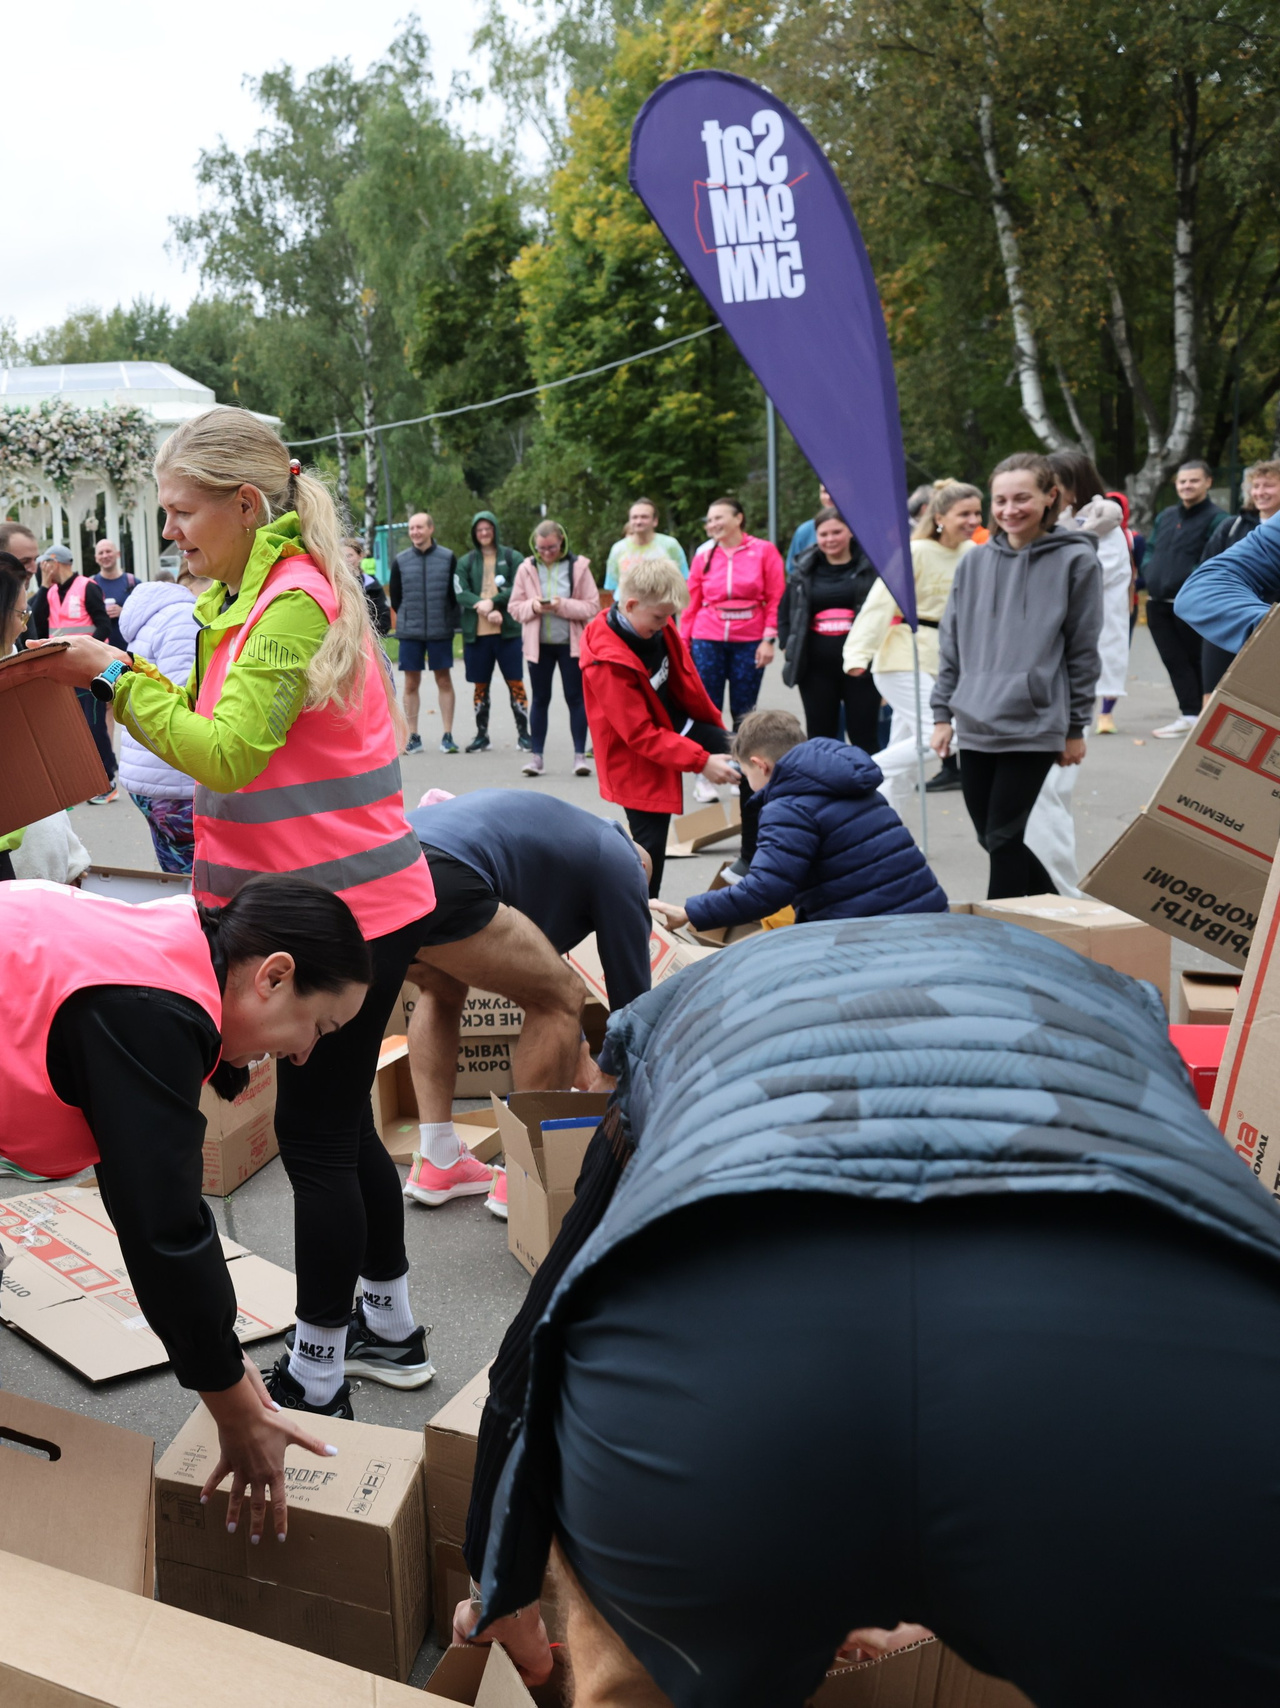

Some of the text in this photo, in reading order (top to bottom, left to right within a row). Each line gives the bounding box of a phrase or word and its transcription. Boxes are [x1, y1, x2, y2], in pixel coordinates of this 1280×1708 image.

[1177, 794, 1245, 832] PREMIUM
[1143, 866, 1258, 931] КОРОБОМ!
[1151, 895, 1250, 958] ЫВАТЬ!
[461, 1012, 522, 1028] НЕ ВСК
[457, 1043, 510, 1058] ЫВАТ
[468, 1060, 511, 1073] КОРО
[1253, 1134, 1269, 1179] ONAL
[1, 1274, 31, 1298] ОТГР
[299, 1339, 335, 1359] M42.2
[284, 1467, 338, 1486] ROFF
